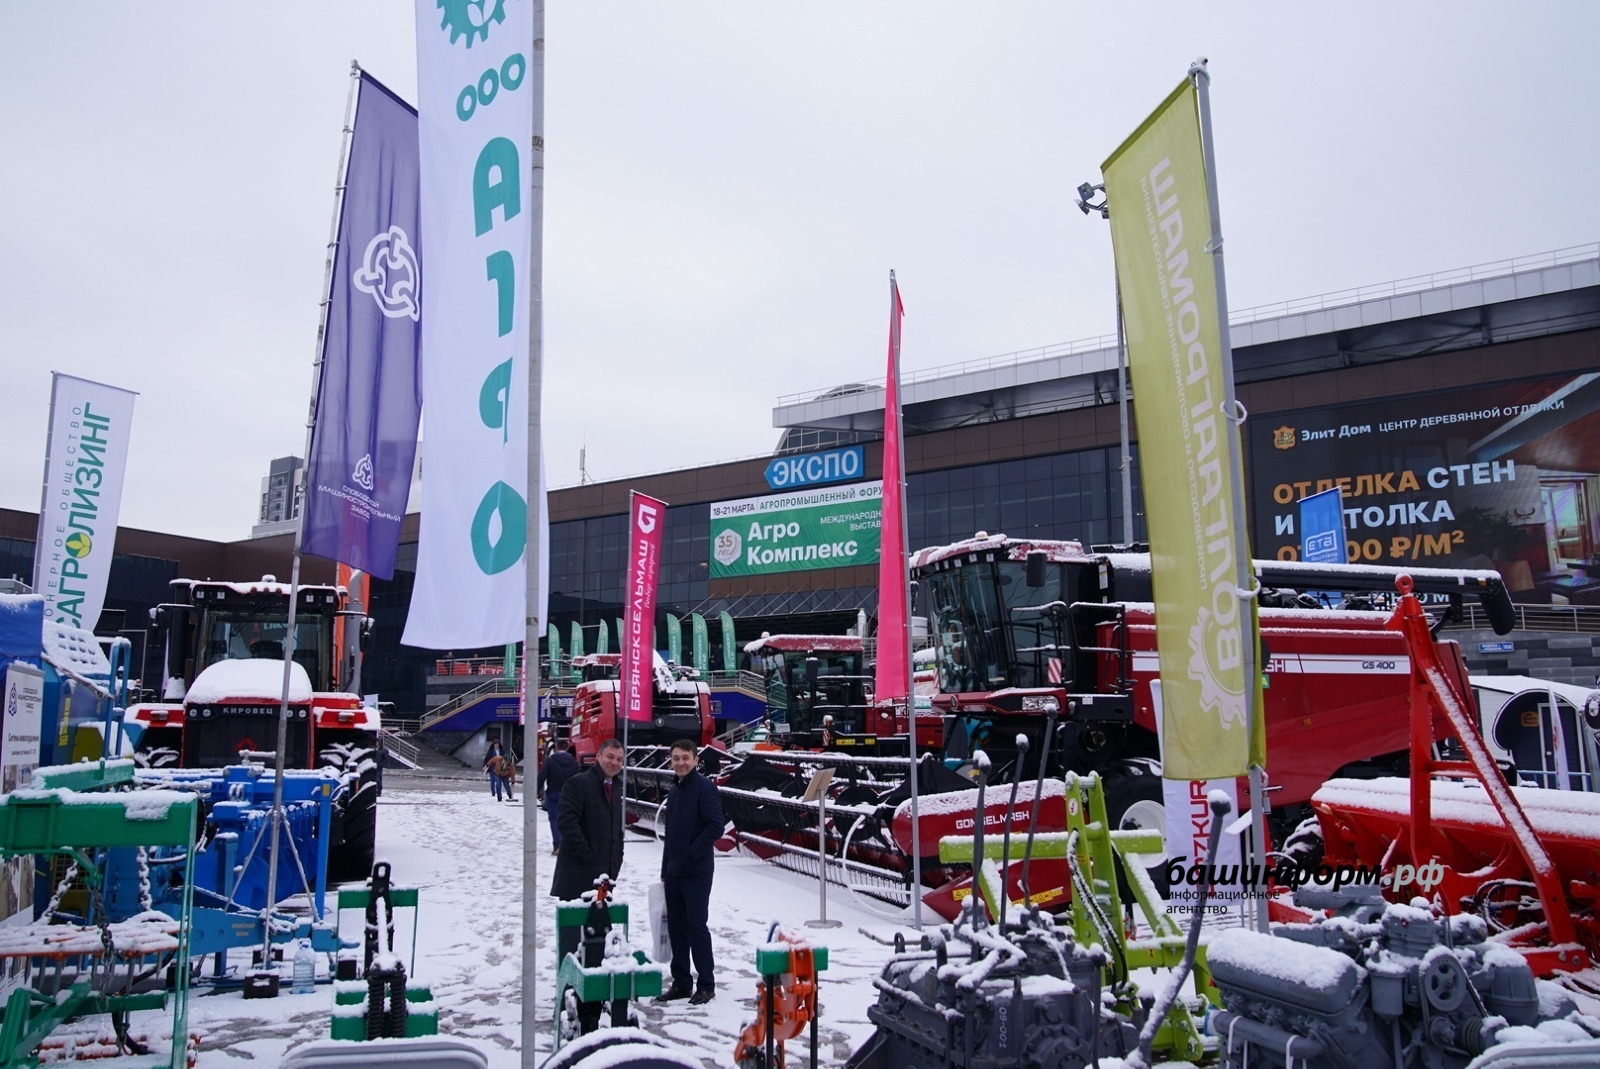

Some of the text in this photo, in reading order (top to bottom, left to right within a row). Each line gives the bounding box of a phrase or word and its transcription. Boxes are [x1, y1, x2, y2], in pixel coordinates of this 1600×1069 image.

[1301, 428, 1336, 442] Элит
[1339, 423, 1371, 439] Дом
[1378, 420, 1418, 433] ЦЕНТР
[1420, 406, 1501, 429] ДЕРЕВЯННОЙ
[60, 406, 82, 511] ОБЩЕСТВО
[772, 450, 859, 486] ЭКСПО
[1427, 459, 1516, 489] СТЕН
[713, 507, 731, 516] 18-21
[732, 503, 756, 513] МАРТА
[760, 489, 856, 511] АГРОПРОМЫШЛЕННЫЙ
[747, 521, 800, 543] Агро
[1275, 515, 1294, 536] И
[718, 535, 733, 548] 35
[747, 540, 858, 565] Комплекс
[630, 540, 649, 711] БРЯНСКСЕЛЬМАШ
[1362, 661, 1395, 670] GS 400
[222, 707, 274, 715] КИРОВЕЦ
